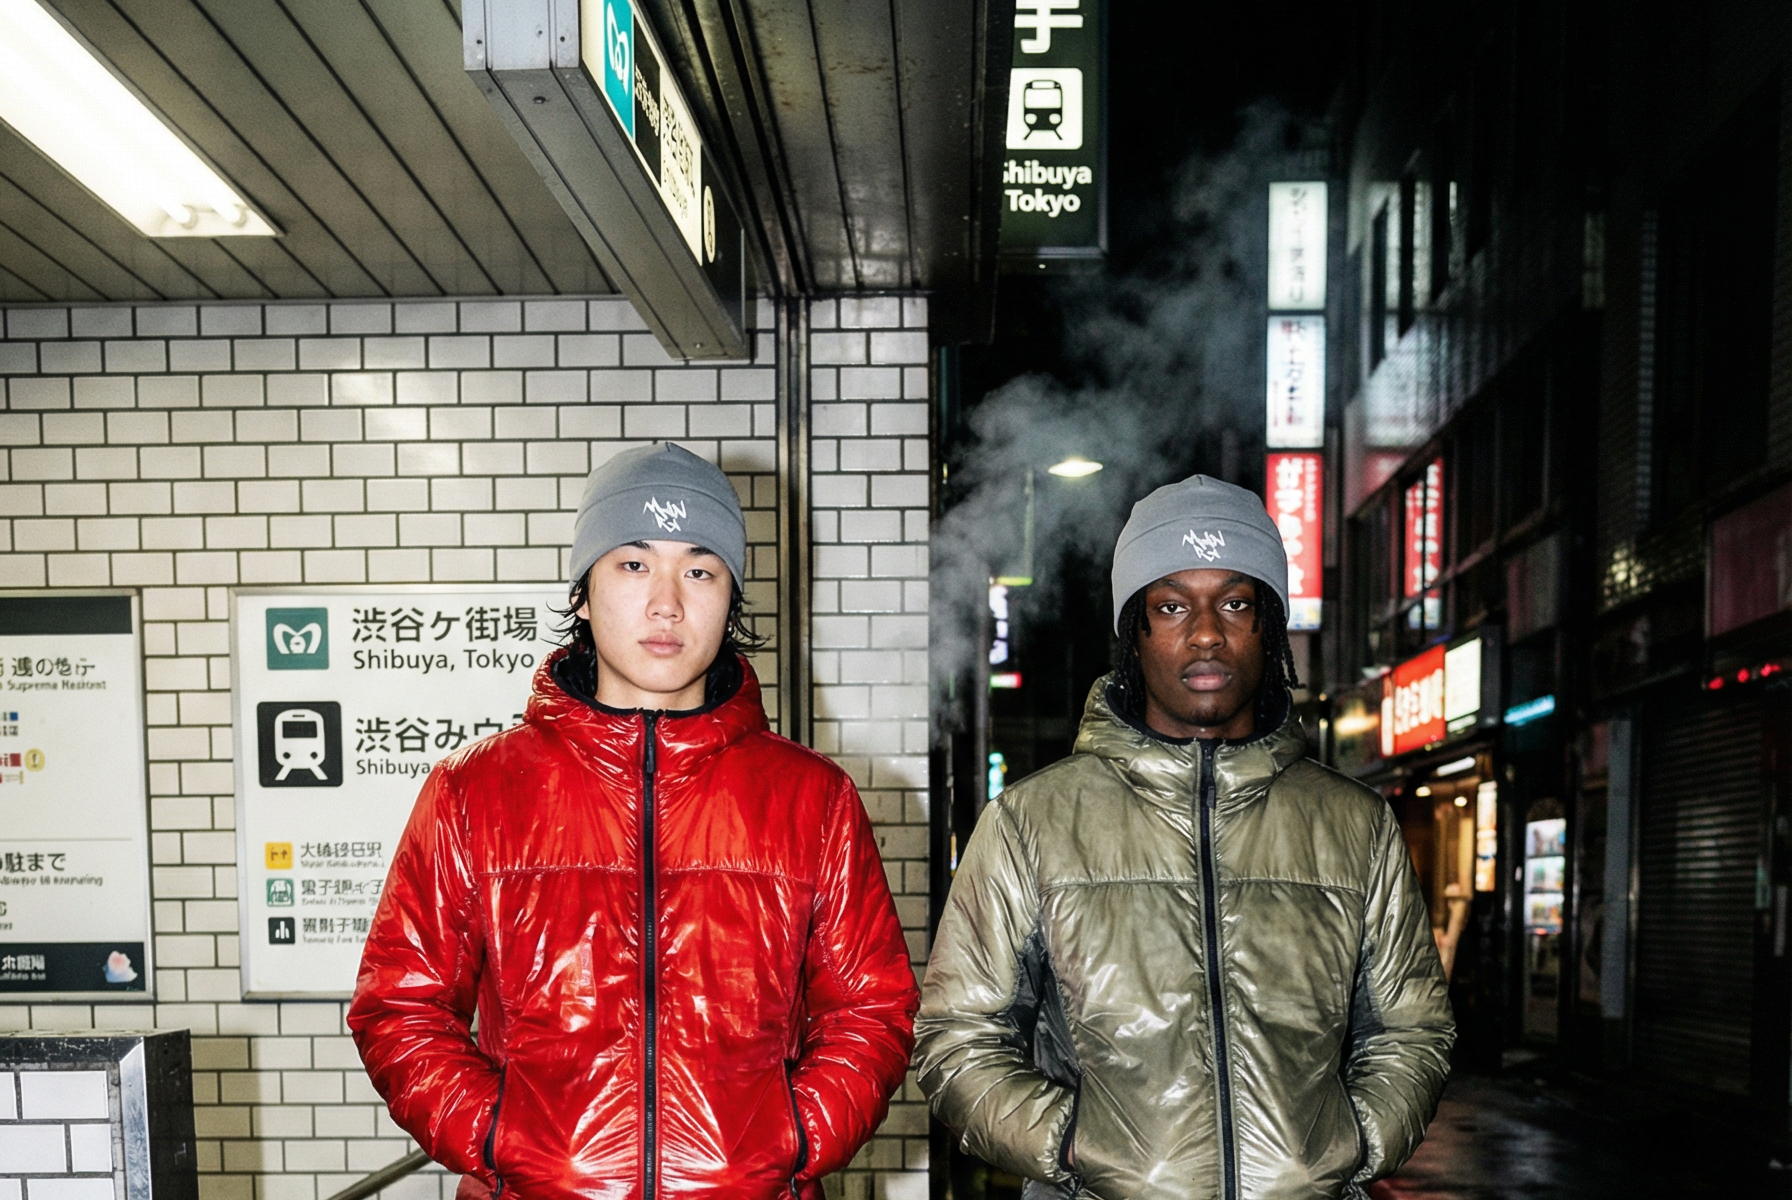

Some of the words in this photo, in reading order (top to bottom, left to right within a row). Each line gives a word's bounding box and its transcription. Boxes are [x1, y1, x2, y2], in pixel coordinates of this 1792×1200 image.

[1004, 188, 1081, 218] Tokyo
[353, 649, 455, 674] Shibuya,
[463, 649, 534, 674] Tokyo
[356, 758, 431, 779] Shibuya
